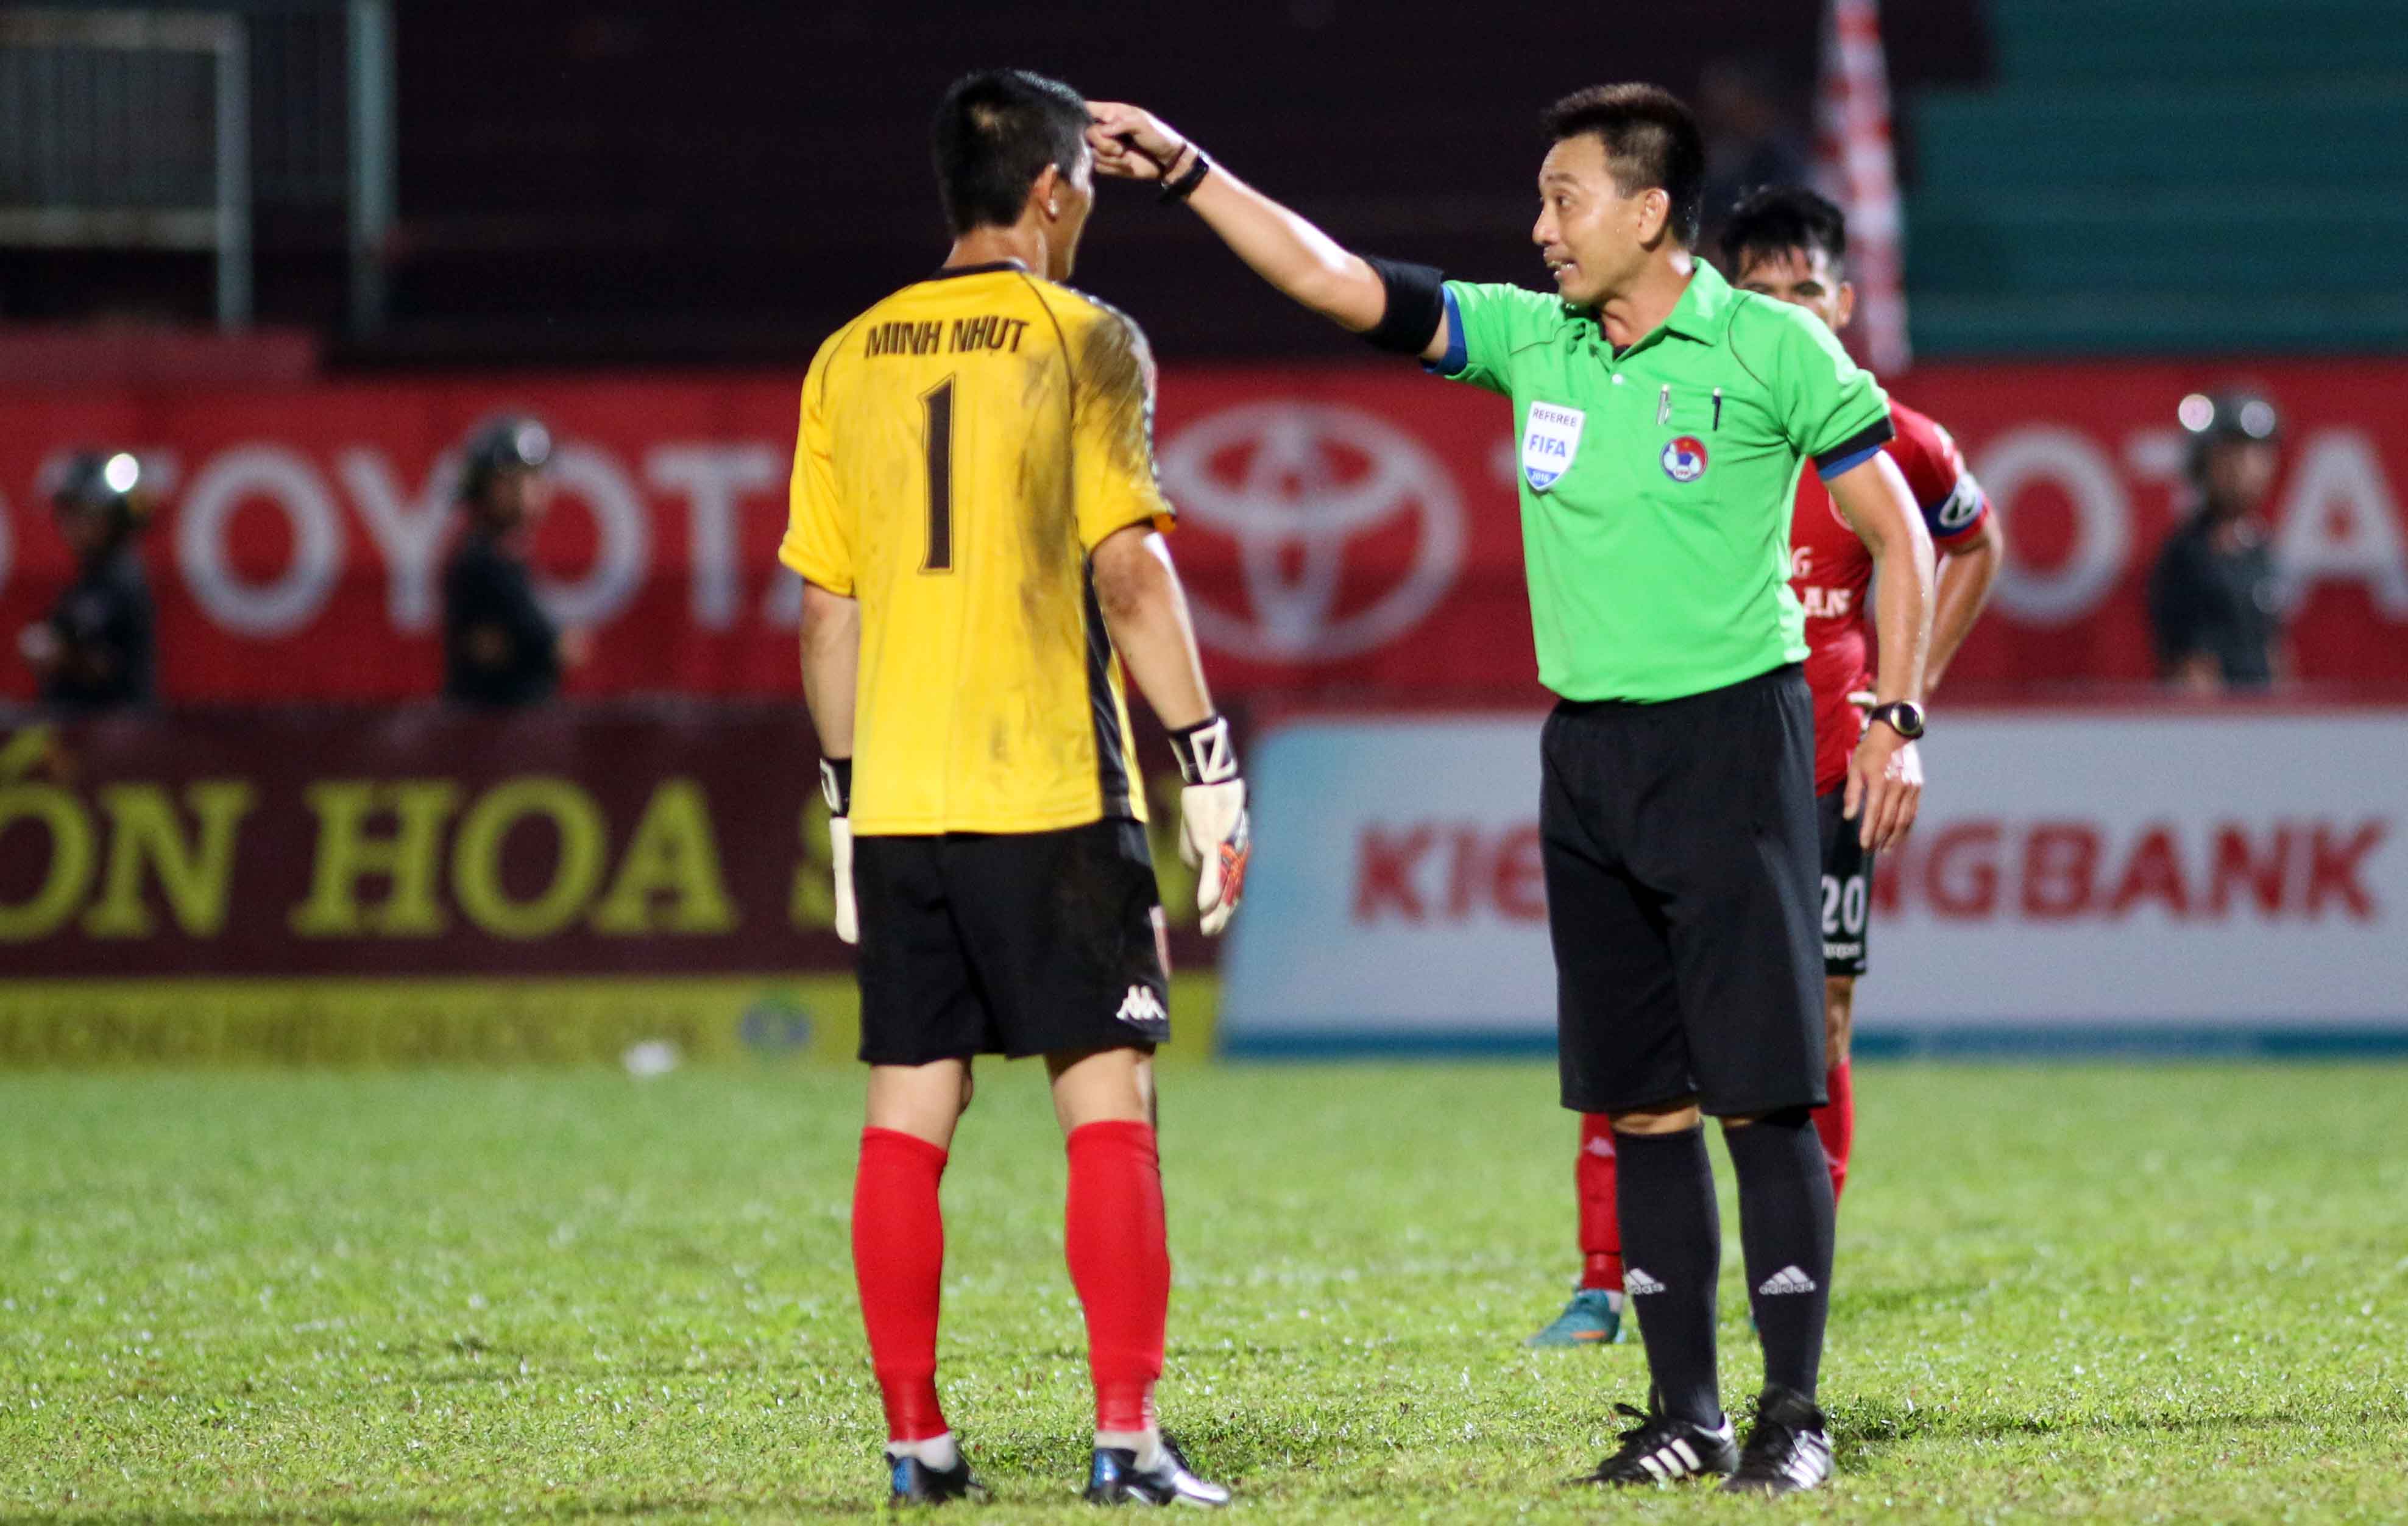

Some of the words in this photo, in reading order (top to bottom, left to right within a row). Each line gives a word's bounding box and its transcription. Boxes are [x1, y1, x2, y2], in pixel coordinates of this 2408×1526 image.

[863, 320, 943, 359] MINH
[1528, 434, 1566, 457] FIFA
[1532, 407, 1578, 427] REFEREE
[918, 372, 955, 576] 1
[34, 440, 804, 640] OYOT
[288, 777, 737, 941] HOA
[1350, 818, 2385, 925] KIEGBANK
[1821, 874, 1866, 935] 20
[1758, 1280, 1816, 1295] adidas
